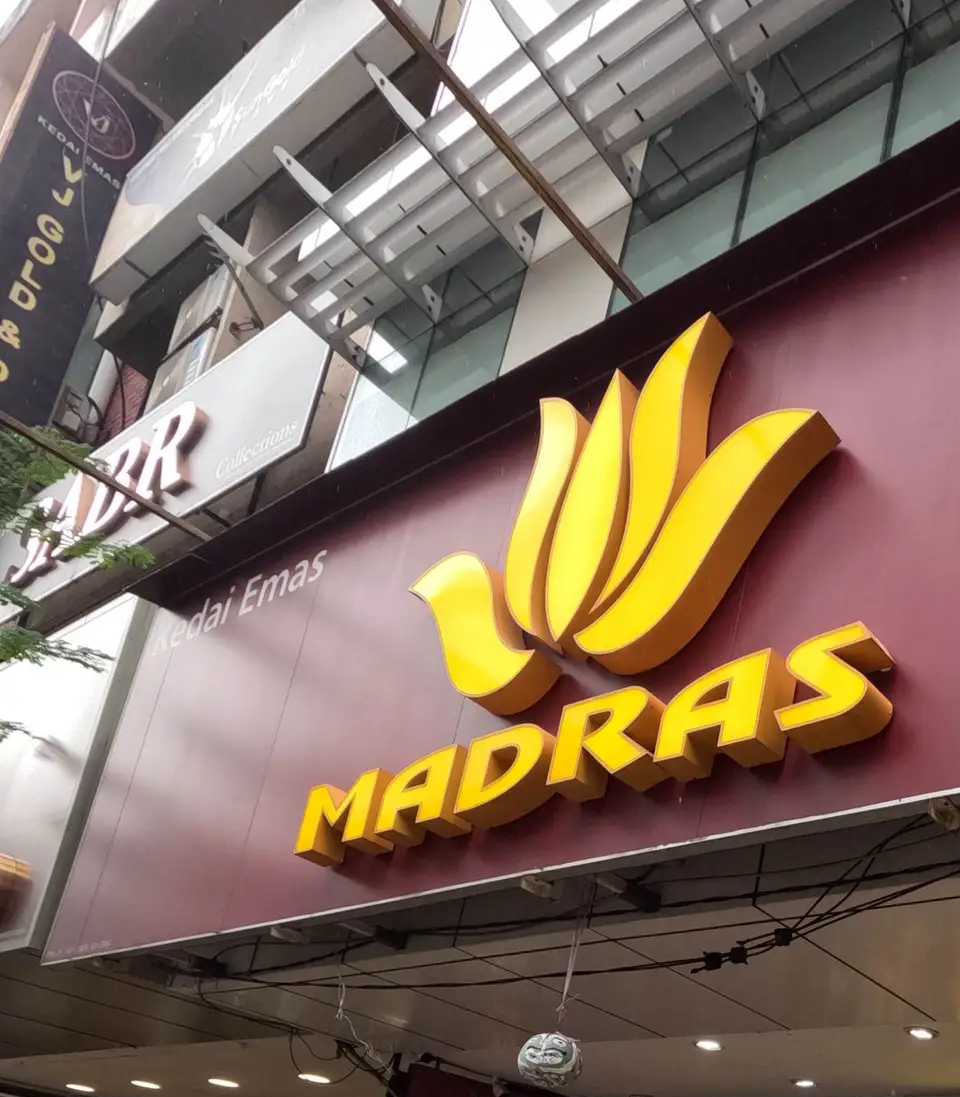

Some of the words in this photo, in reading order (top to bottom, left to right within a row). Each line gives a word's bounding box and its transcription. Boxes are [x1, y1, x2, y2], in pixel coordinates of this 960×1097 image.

[37, 114, 80, 155] KEDAI
[84, 155, 121, 190] EMAS
[0, 318, 21, 350] &
[215, 421, 299, 479] Collections
[152, 585, 236, 656] Kedai
[237, 549, 328, 617] Emas
[293, 620, 897, 867] MADRAS
